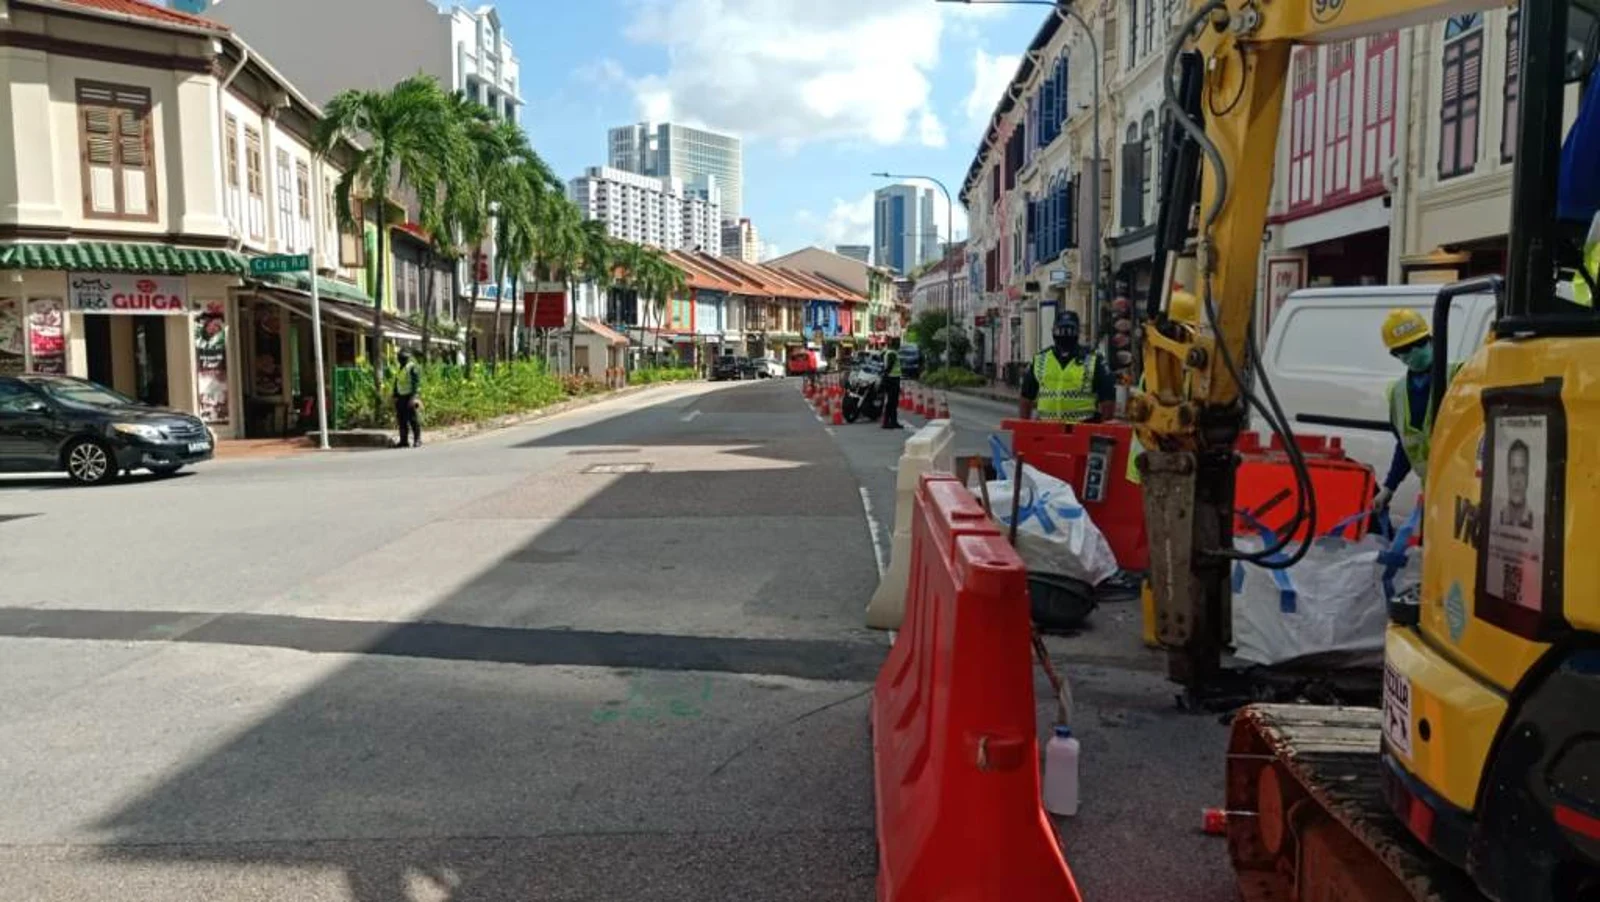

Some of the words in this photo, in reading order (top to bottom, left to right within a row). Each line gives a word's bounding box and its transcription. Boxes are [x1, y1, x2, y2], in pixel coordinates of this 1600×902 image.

[255, 258, 288, 272] Craig
[291, 256, 307, 269] Rd
[112, 293, 182, 309] GUIGA
